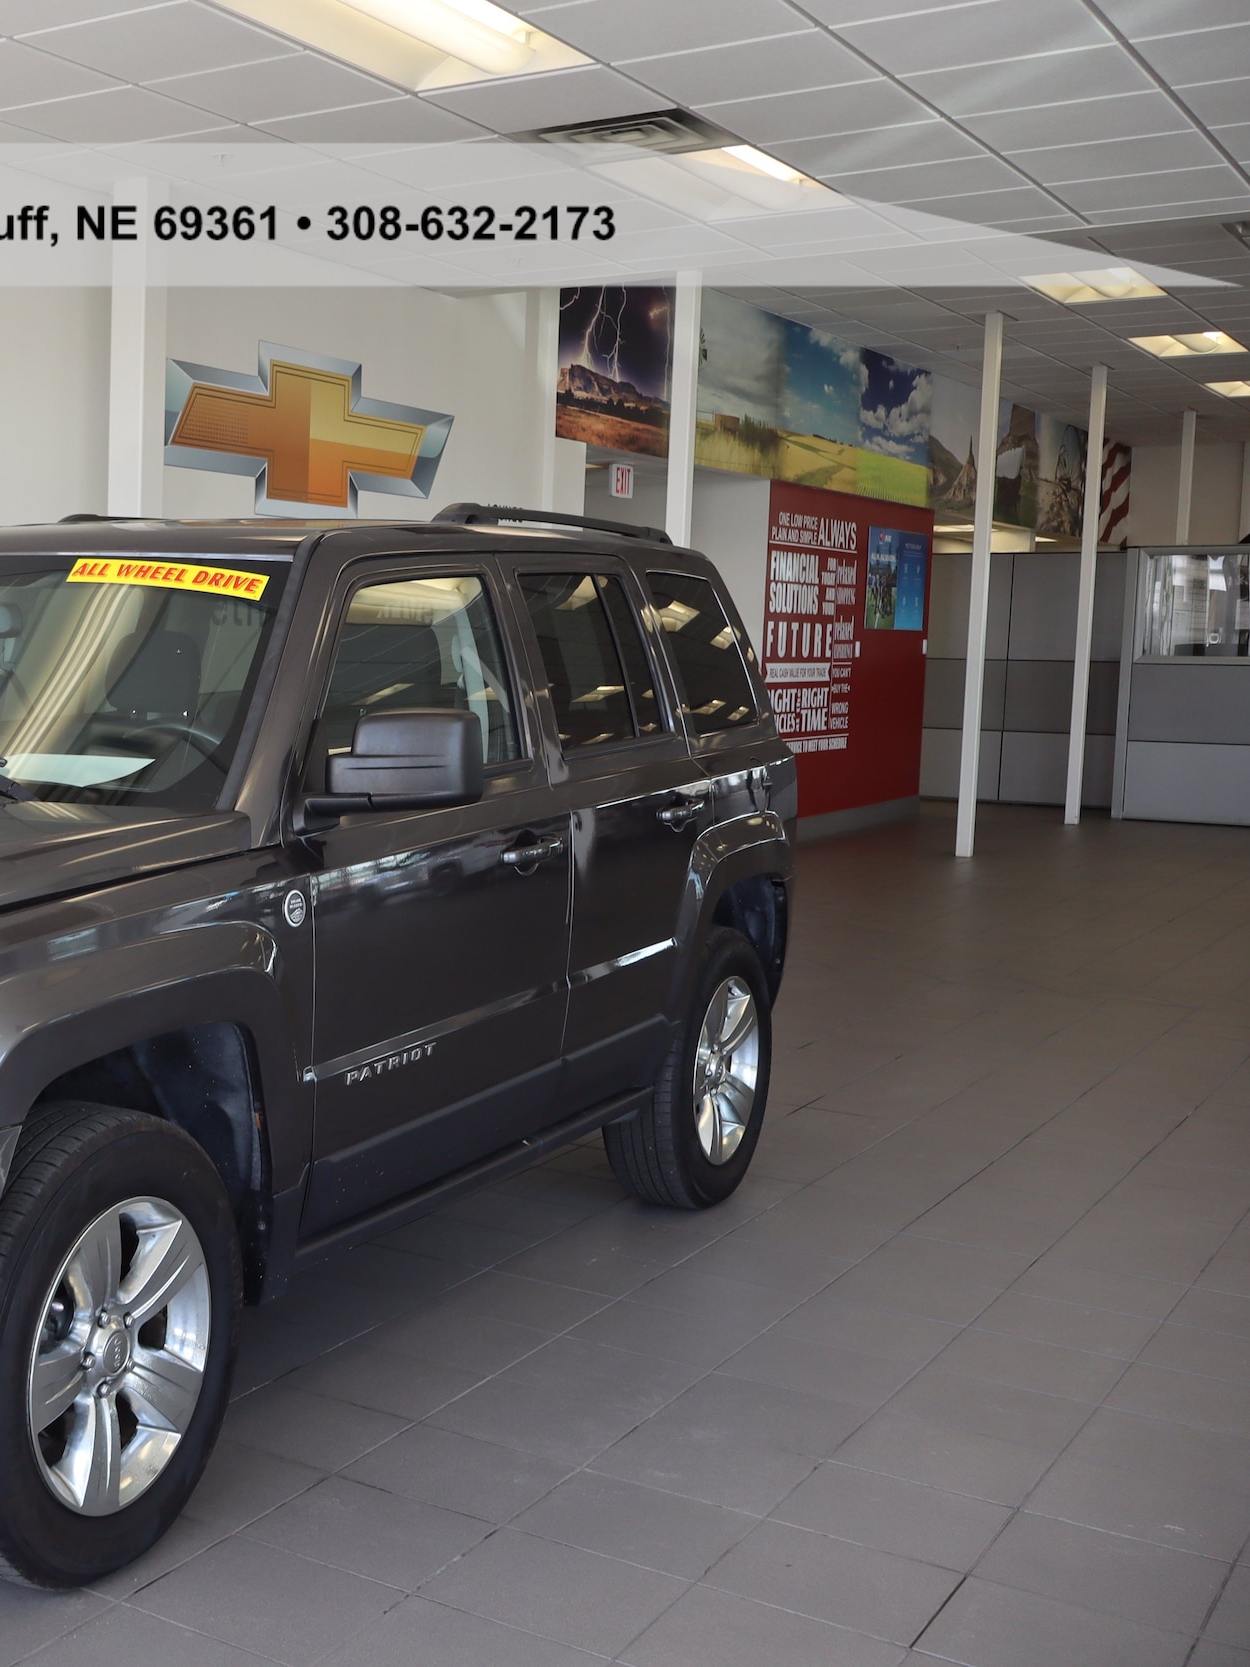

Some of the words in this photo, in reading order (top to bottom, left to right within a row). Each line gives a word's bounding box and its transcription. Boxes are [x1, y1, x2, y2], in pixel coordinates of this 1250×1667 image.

[616, 466, 631, 495] EXIT
[772, 526, 788, 541] PLAIN
[787, 528, 799, 543] AND
[779, 511, 790, 526] ONE
[791, 513, 803, 528] LOW
[803, 515, 818, 530] PRICE
[818, 517, 857, 550] ALWAYS
[72, 562, 111, 577] ALL
[116, 563, 188, 582] WHEEL
[192, 570, 263, 593] DRIVE
[770, 550, 819, 584] FINANCIAL
[769, 581, 819, 615] SOLUTIONS
[766, 621, 832, 658] FUTURE
[768, 688, 797, 713] IGHT
[801, 687, 829, 708] RIGHT
[832, 702, 848, 714] WRONG
[801, 708, 828, 732] TIME
[345, 1042, 437, 1085] PATRIOT
